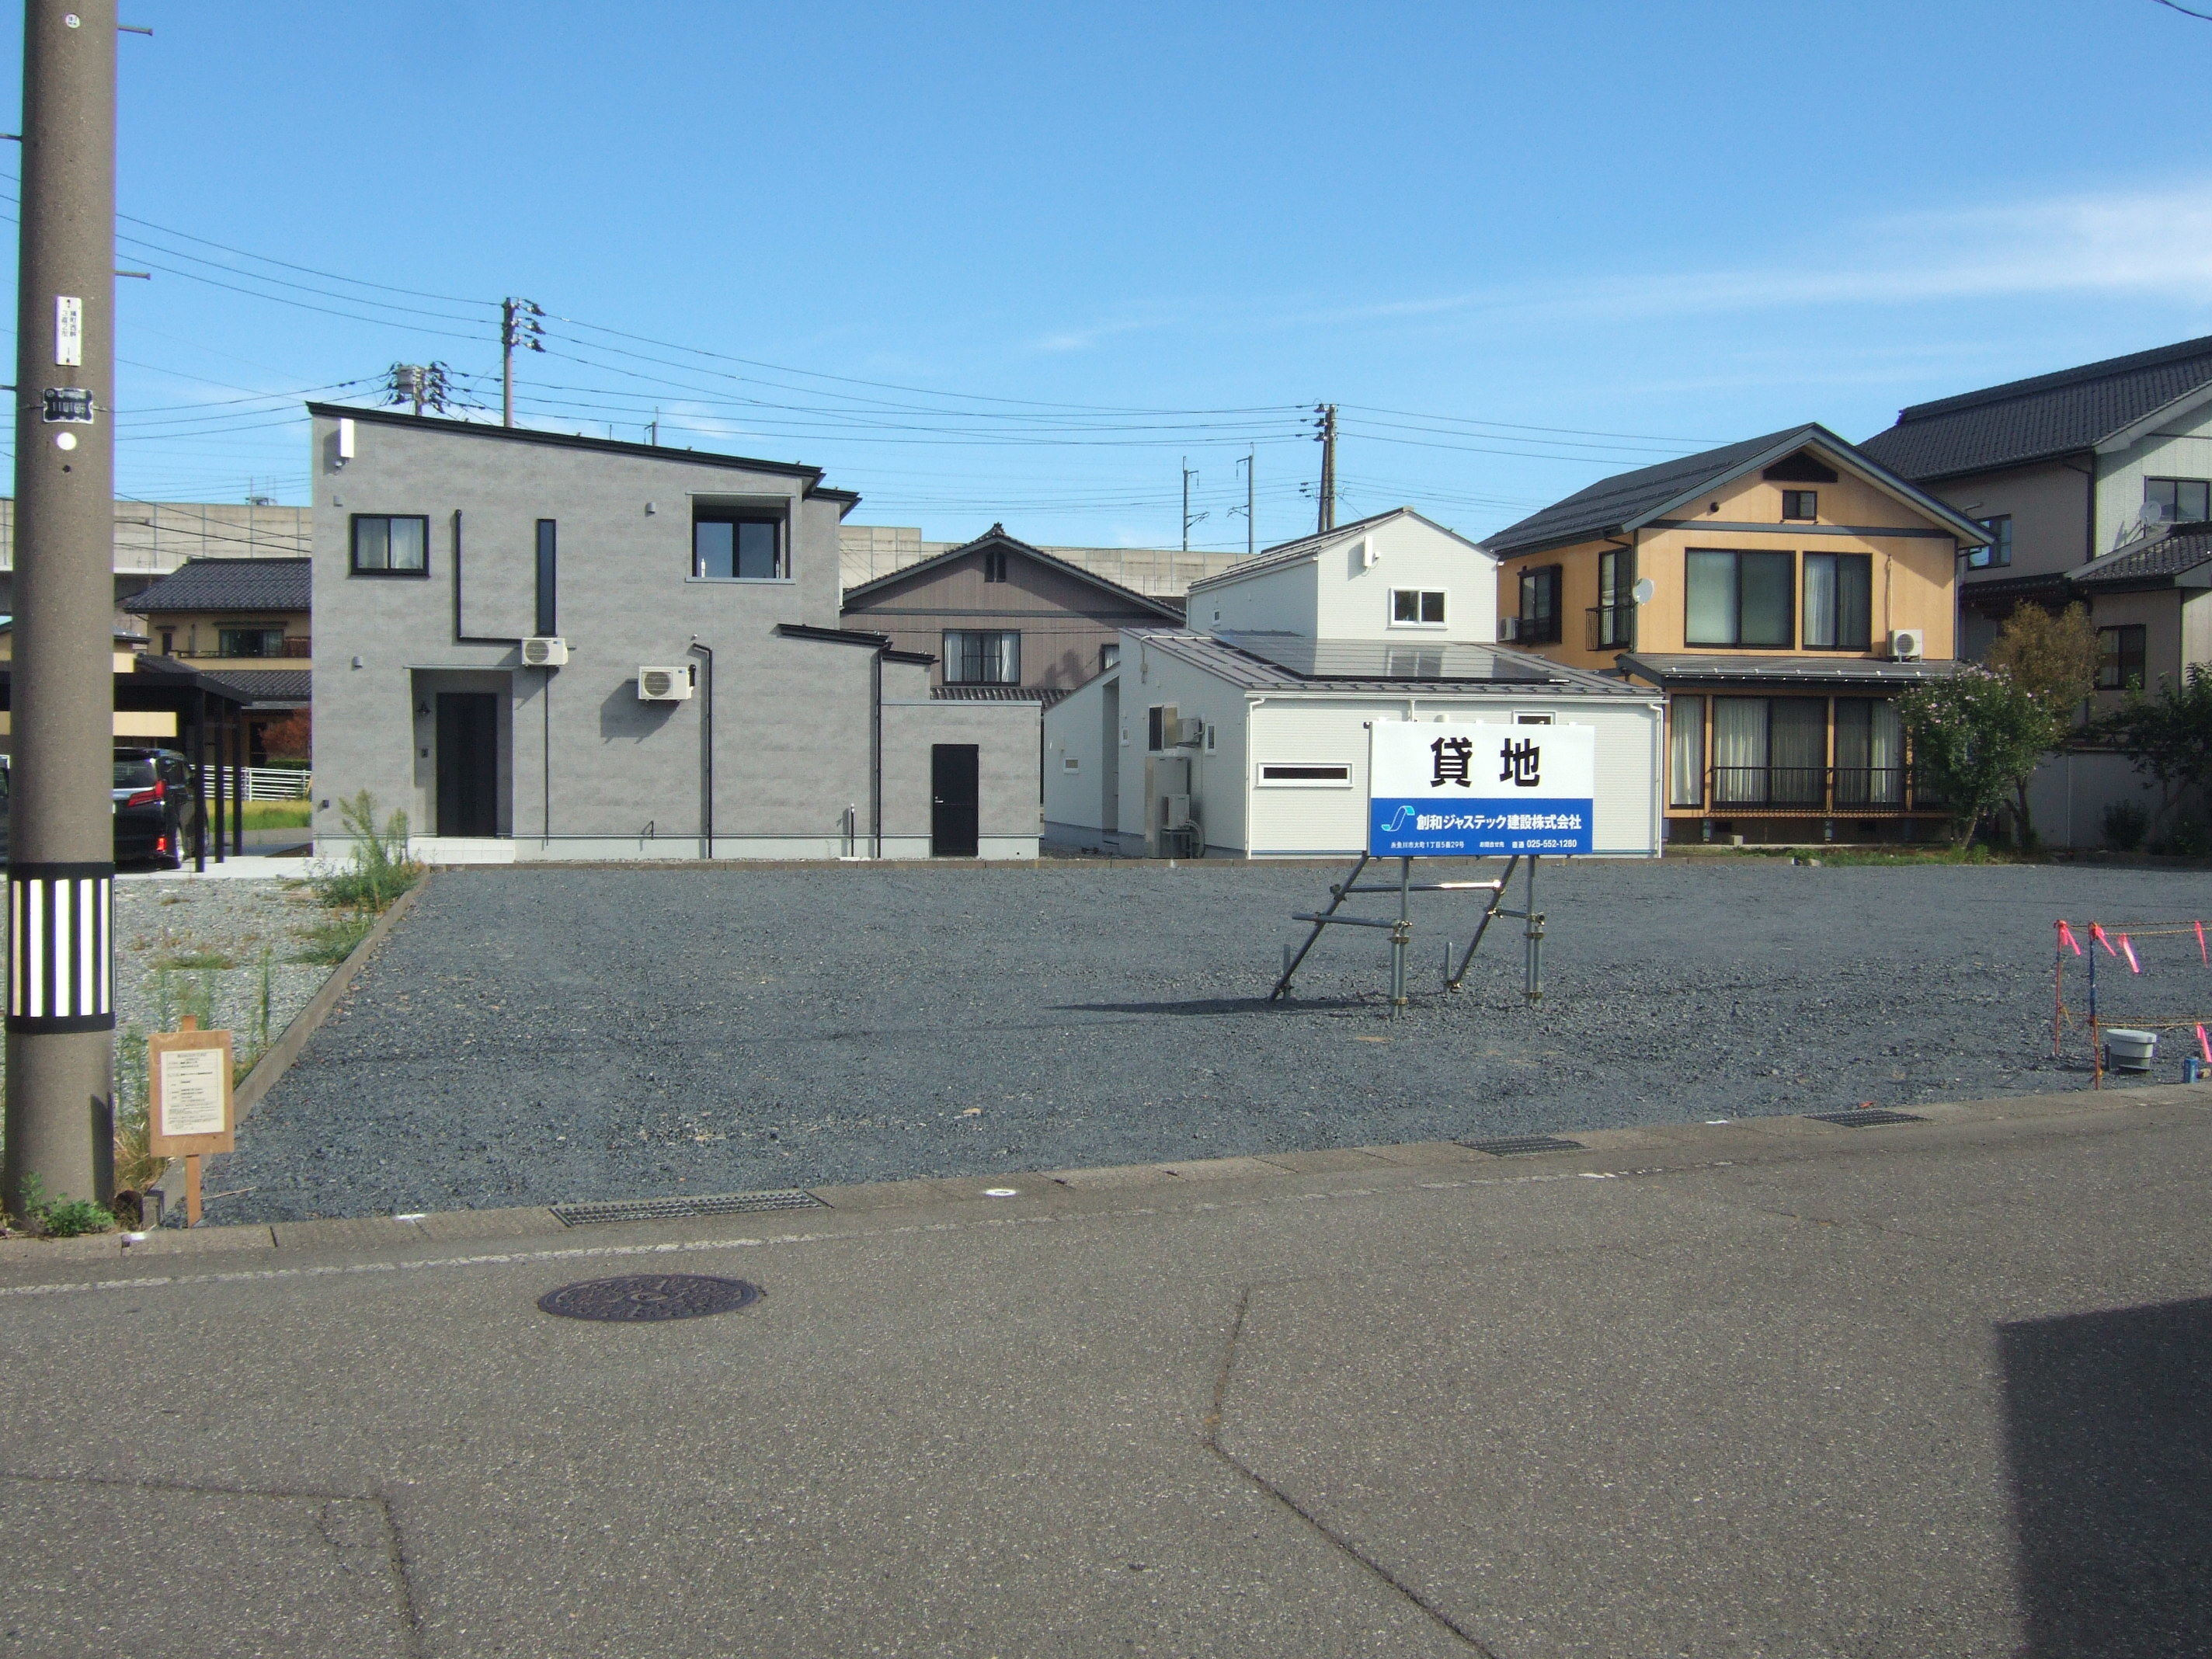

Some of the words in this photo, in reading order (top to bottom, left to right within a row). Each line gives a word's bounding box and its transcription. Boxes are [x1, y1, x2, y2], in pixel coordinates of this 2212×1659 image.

[1430, 736, 1541, 788] 貸地
[1416, 814, 1582, 831] 創和ジャステック建設株式会社
